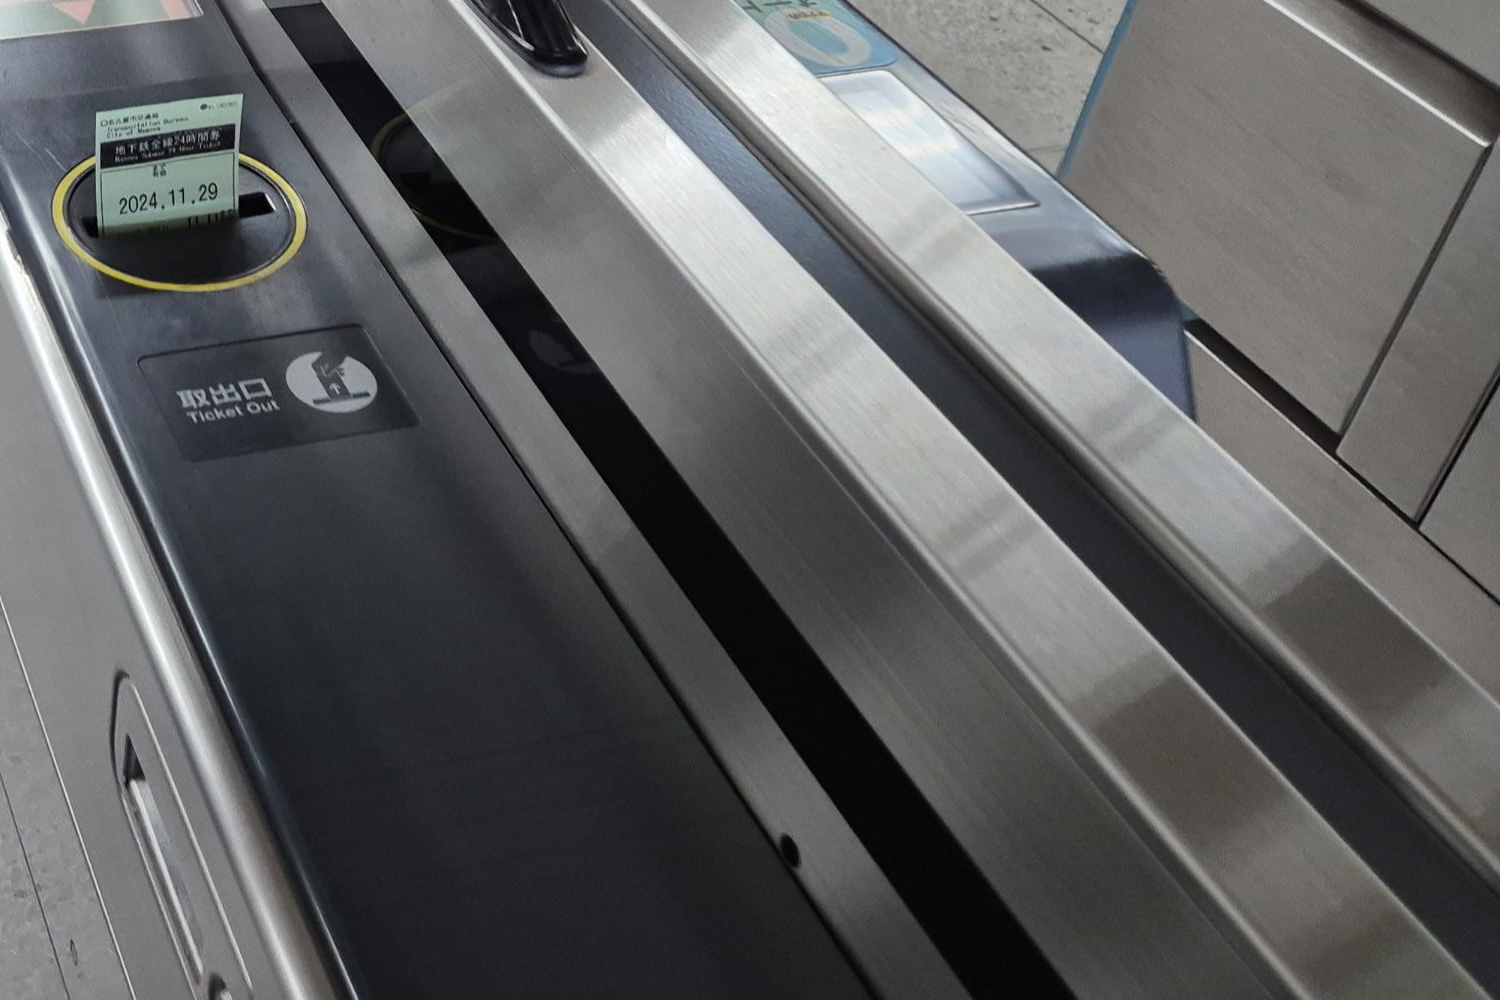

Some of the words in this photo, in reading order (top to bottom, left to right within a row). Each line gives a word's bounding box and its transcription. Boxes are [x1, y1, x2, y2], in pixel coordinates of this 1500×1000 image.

[119, 182, 218, 215] 2024.11.29
[176, 377, 273, 409] 取出口
[186, 405, 244, 424] Ticket
[246, 399, 280, 414] Out
